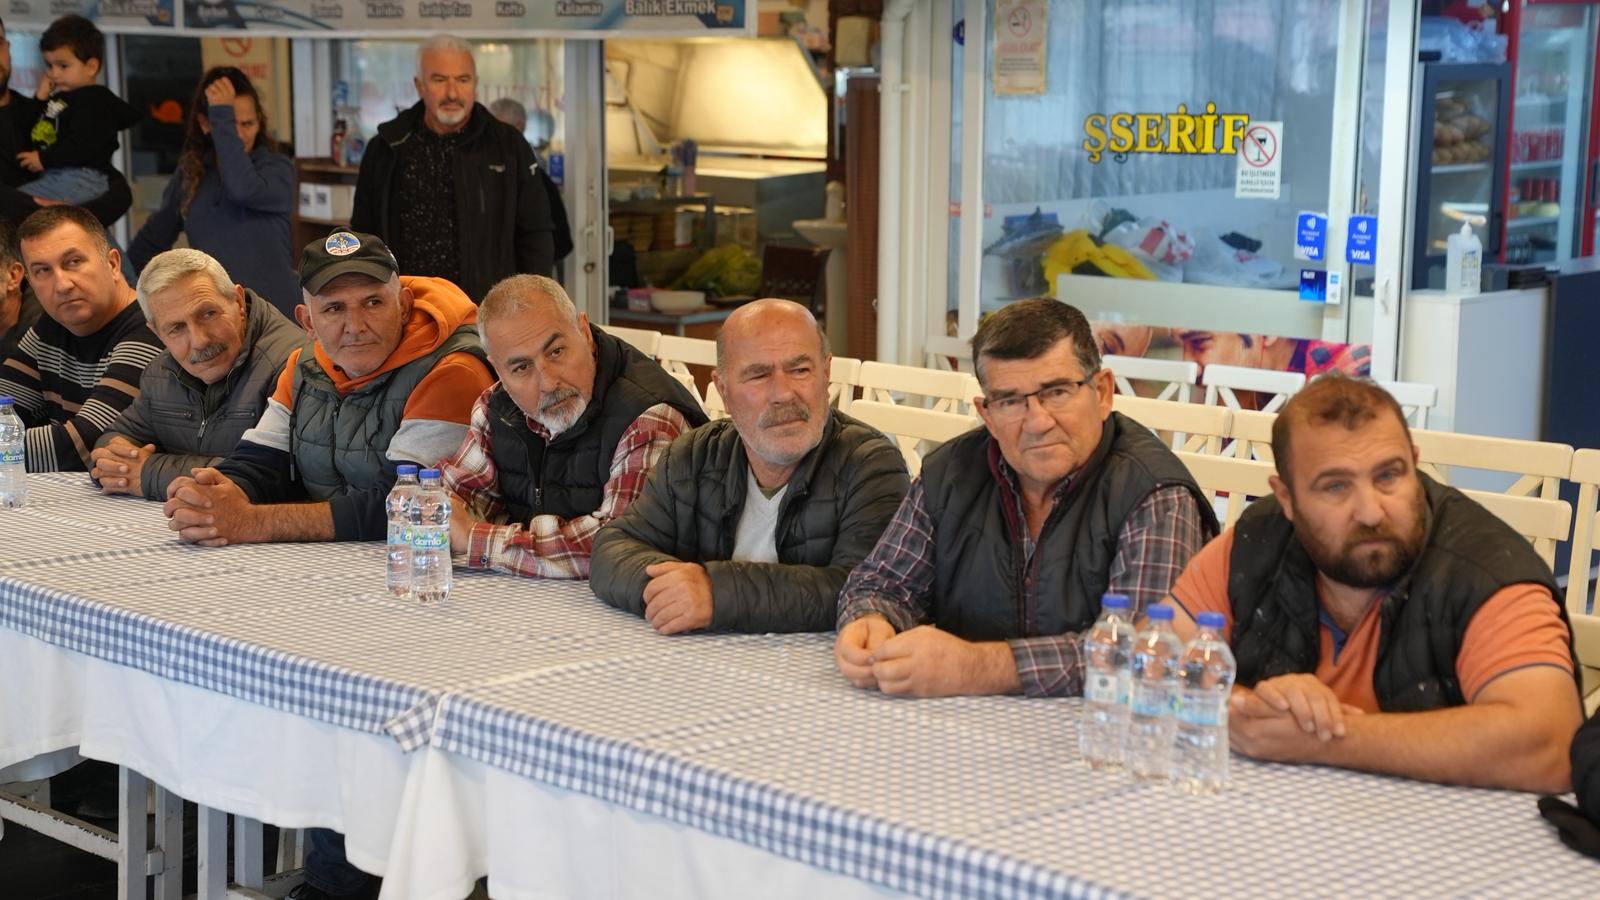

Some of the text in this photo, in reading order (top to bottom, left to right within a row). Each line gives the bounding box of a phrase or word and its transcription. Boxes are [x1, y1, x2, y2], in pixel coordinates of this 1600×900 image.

[556, 1, 603, 16] Kalamar
[665, 0, 717, 15] Ekmek
[1351, 249, 1370, 260] VISA
[415, 536, 442, 545] damla
